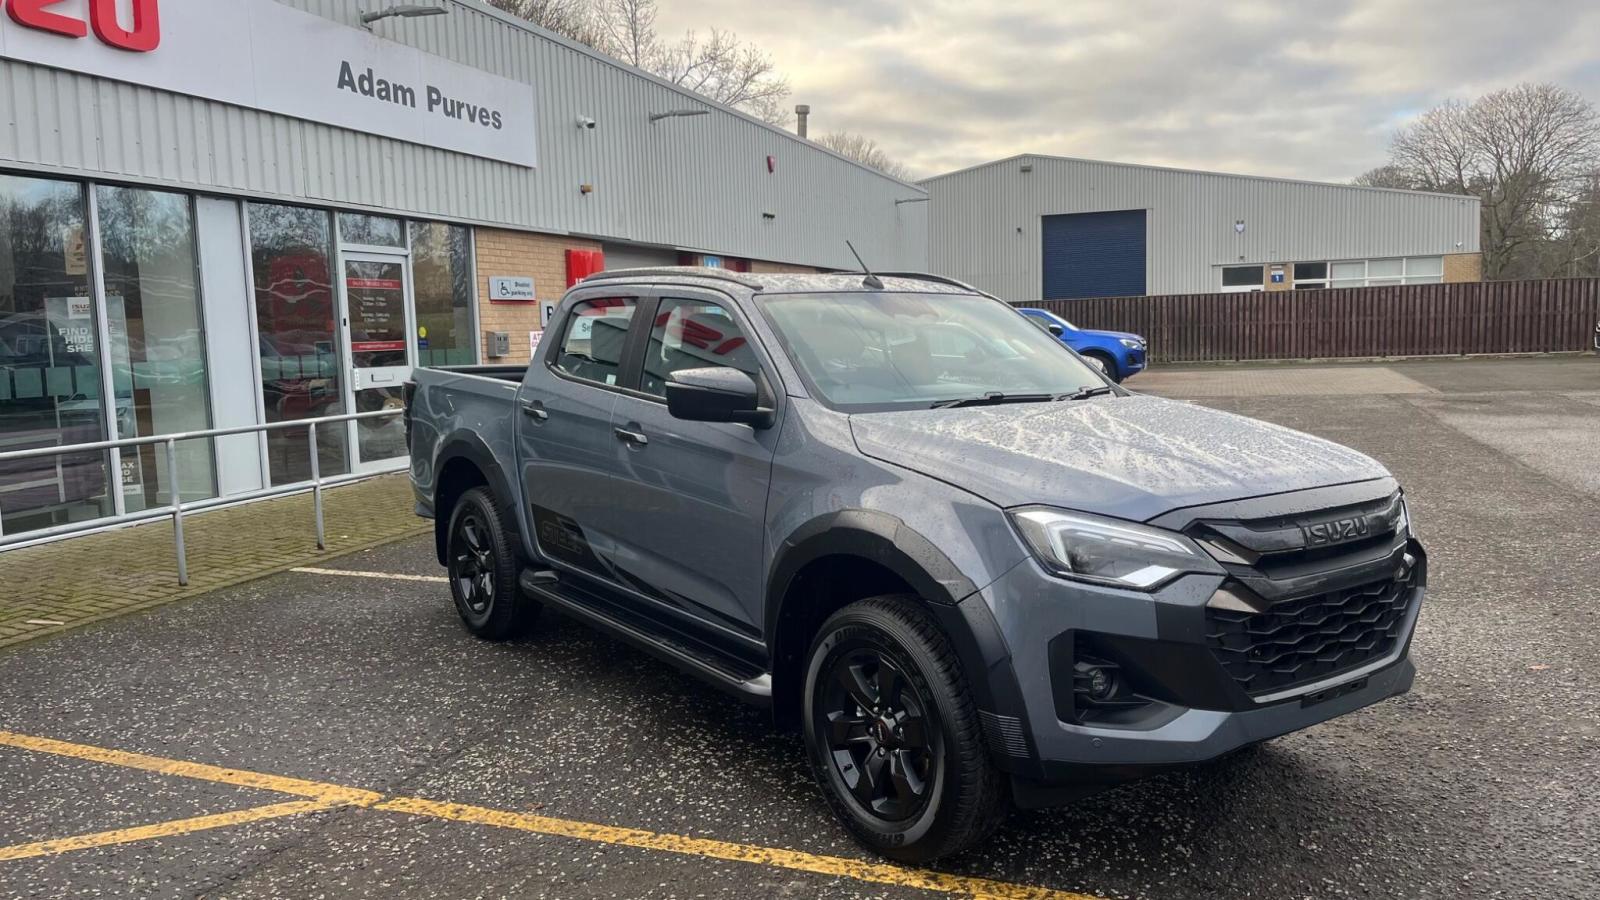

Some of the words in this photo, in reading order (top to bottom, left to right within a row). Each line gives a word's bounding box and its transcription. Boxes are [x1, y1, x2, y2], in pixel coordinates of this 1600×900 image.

[337, 60, 416, 108] Adam
[426, 84, 503, 131] Purves
[58, 327, 88, 336] FIND
[66, 344, 94, 353] SHE
[1303, 516, 1368, 546] ISUZU
